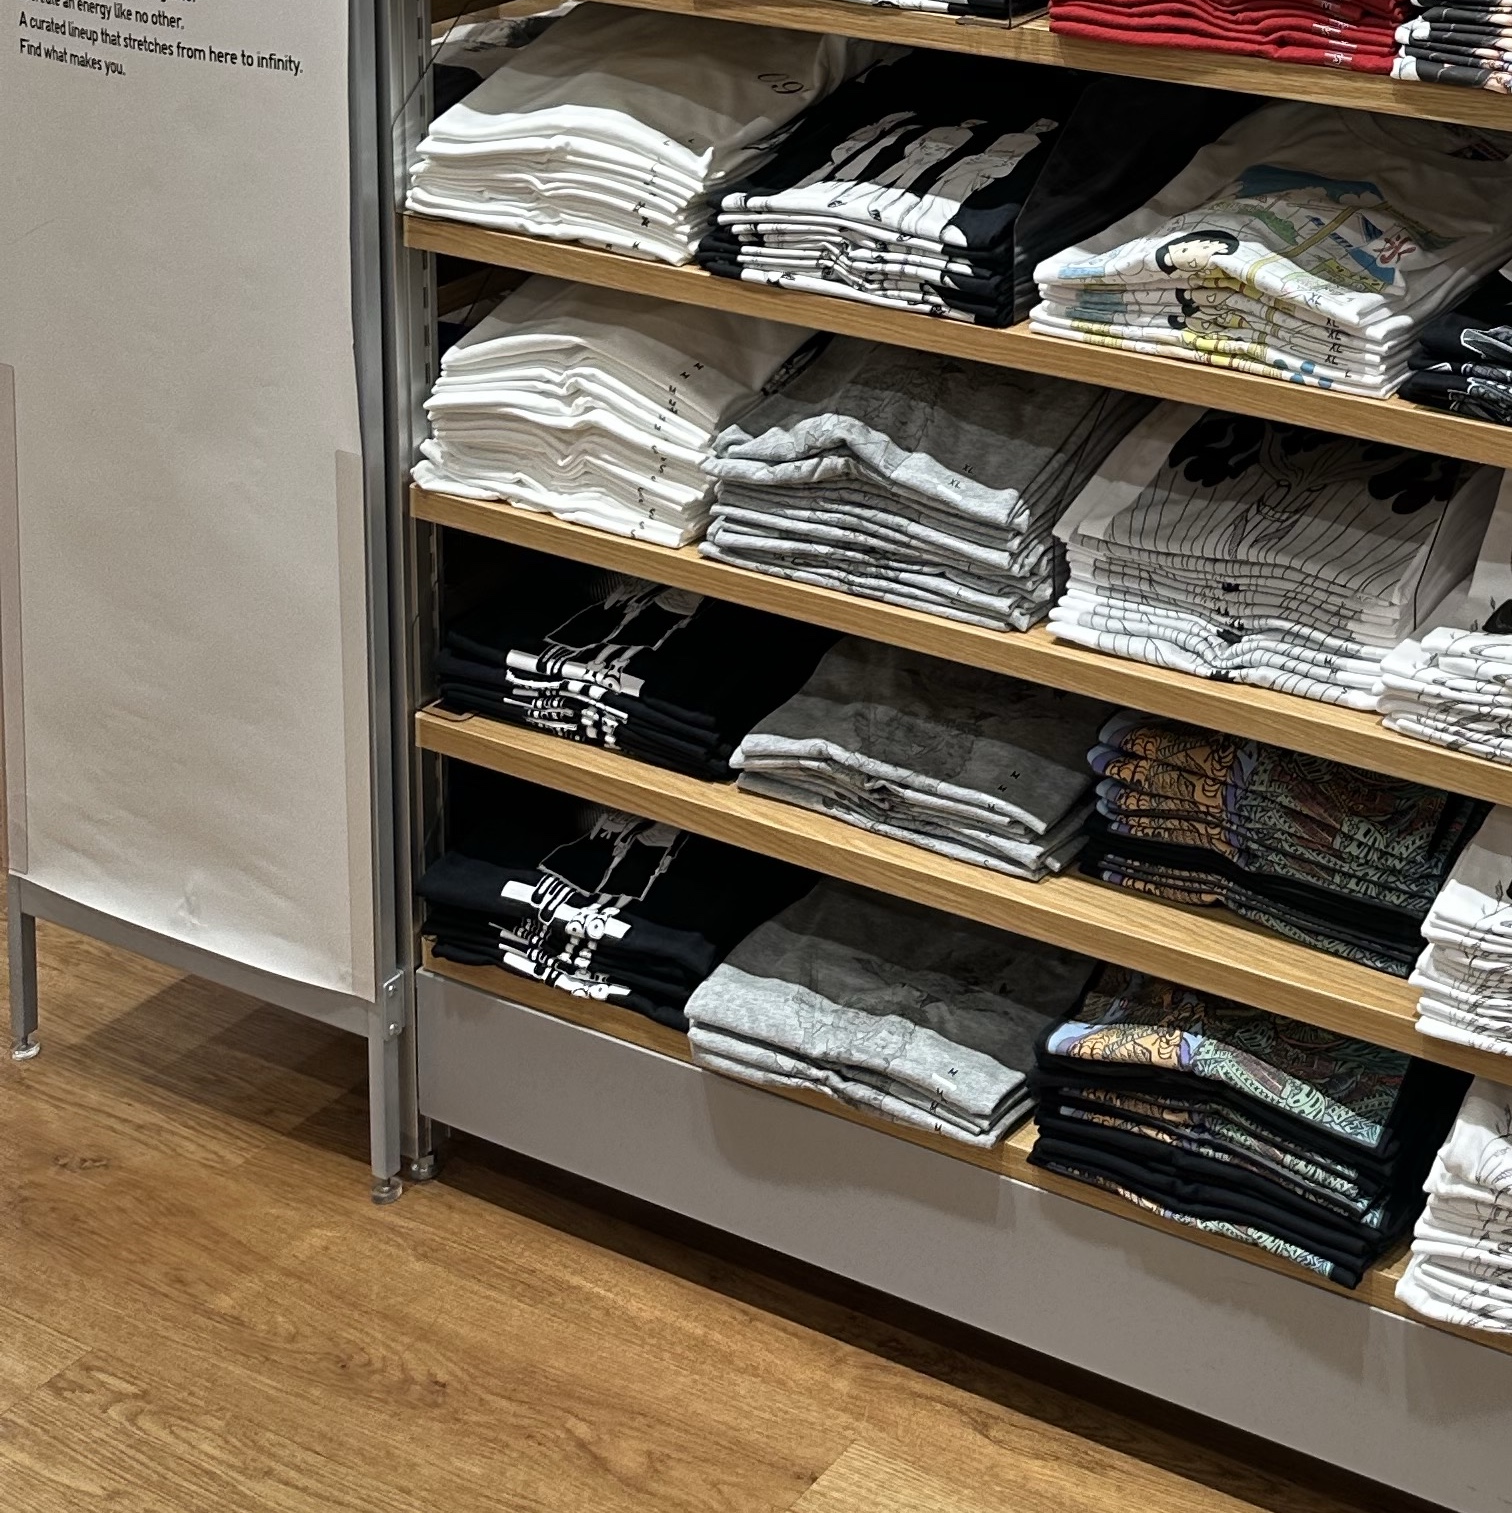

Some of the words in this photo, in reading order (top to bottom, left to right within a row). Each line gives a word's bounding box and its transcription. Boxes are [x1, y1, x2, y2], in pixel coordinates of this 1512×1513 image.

[77, 0, 112, 20] energy
[114, 2, 132, 21] like
[151, 10, 185, 30] other.
[19, 38, 42, 58] Find
[44, 44, 68, 64] what
[70, 51, 103, 71] makes
[104, 59, 126, 77] you.
[29, 16, 66, 36] curated
[68, 20, 99, 45] lineup
[101, 27, 121, 47] that
[123, 33, 174, 56] stretches
[176, 41, 206, 62] from
[209, 45, 238, 66] here
[257, 51, 303, 76] infinity.
